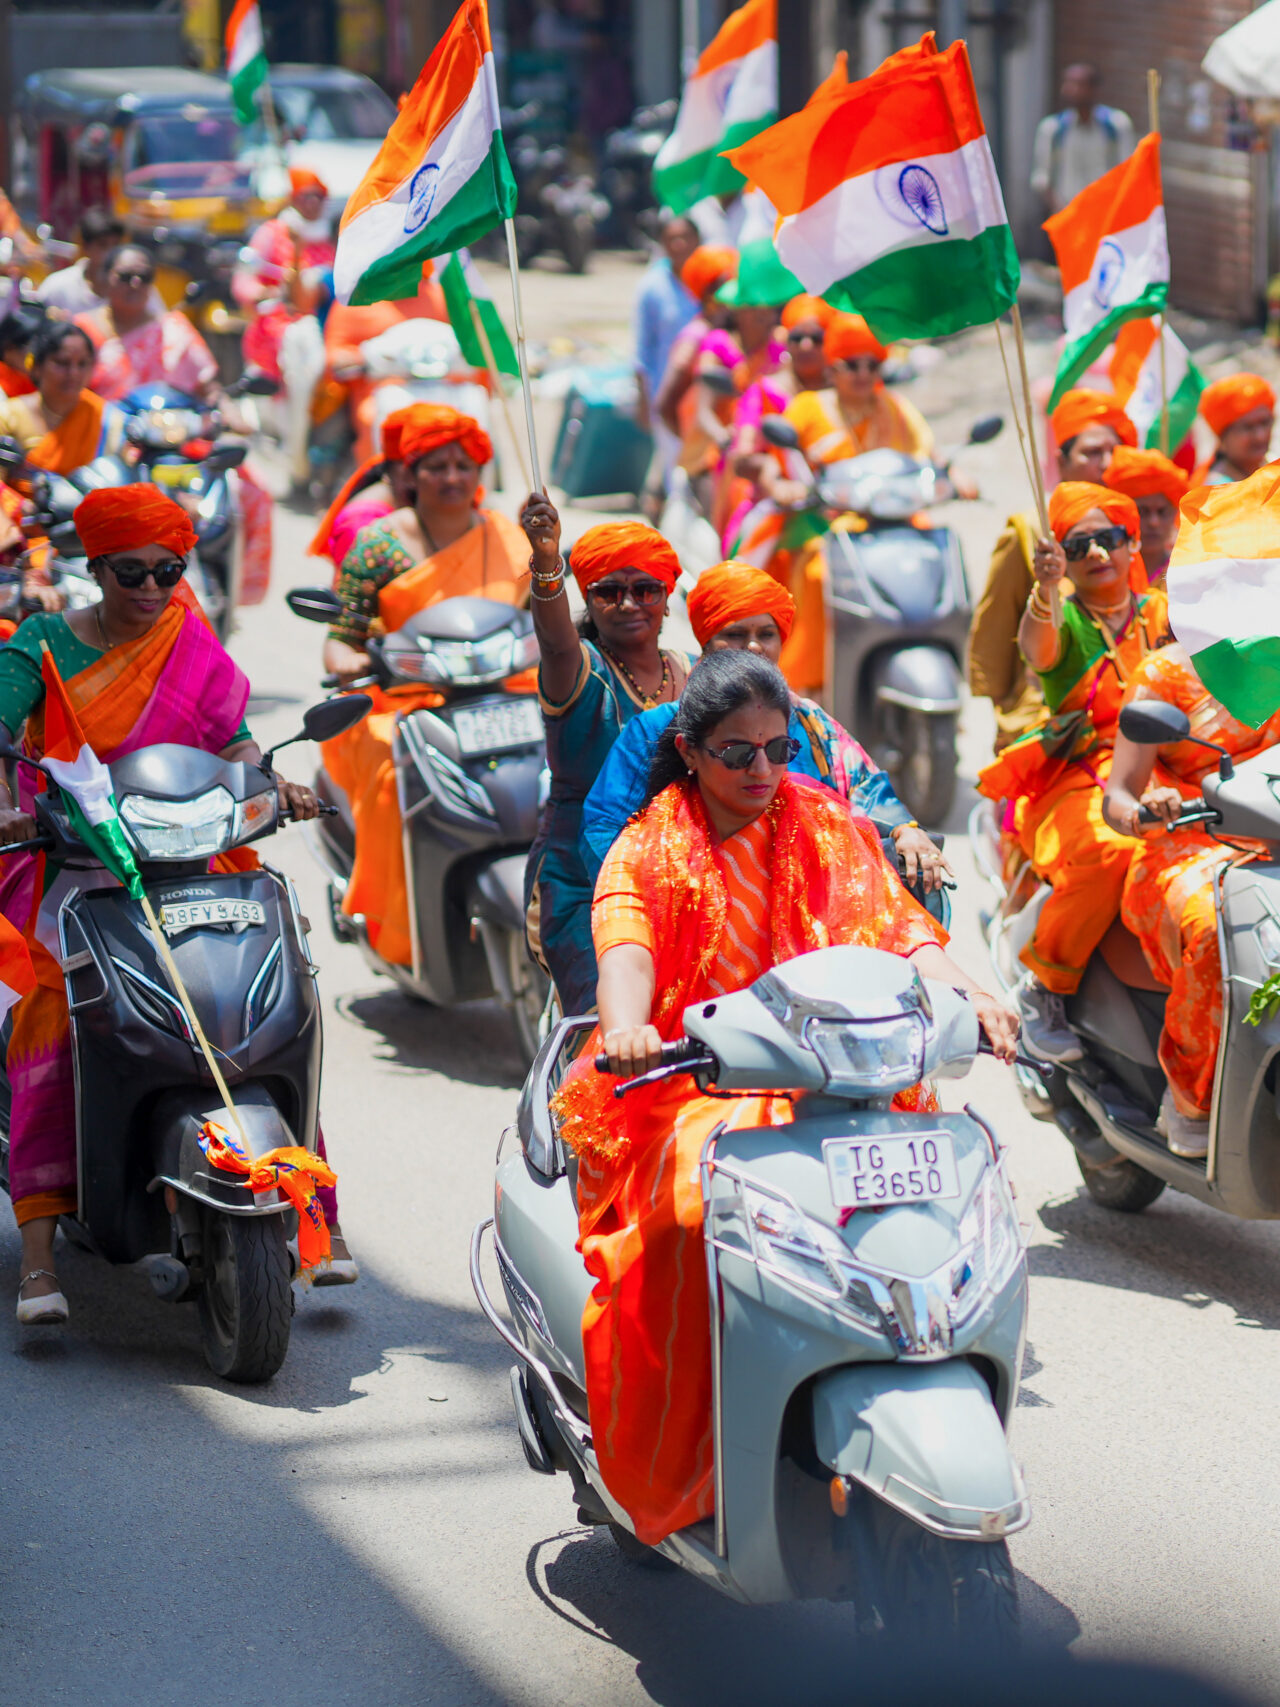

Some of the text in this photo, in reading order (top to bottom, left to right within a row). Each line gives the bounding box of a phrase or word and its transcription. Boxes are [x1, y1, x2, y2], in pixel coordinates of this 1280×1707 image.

[160, 888, 216, 901] HONDA
[849, 1139, 938, 1170] TG 10
[853, 1168, 942, 1200] E3650
